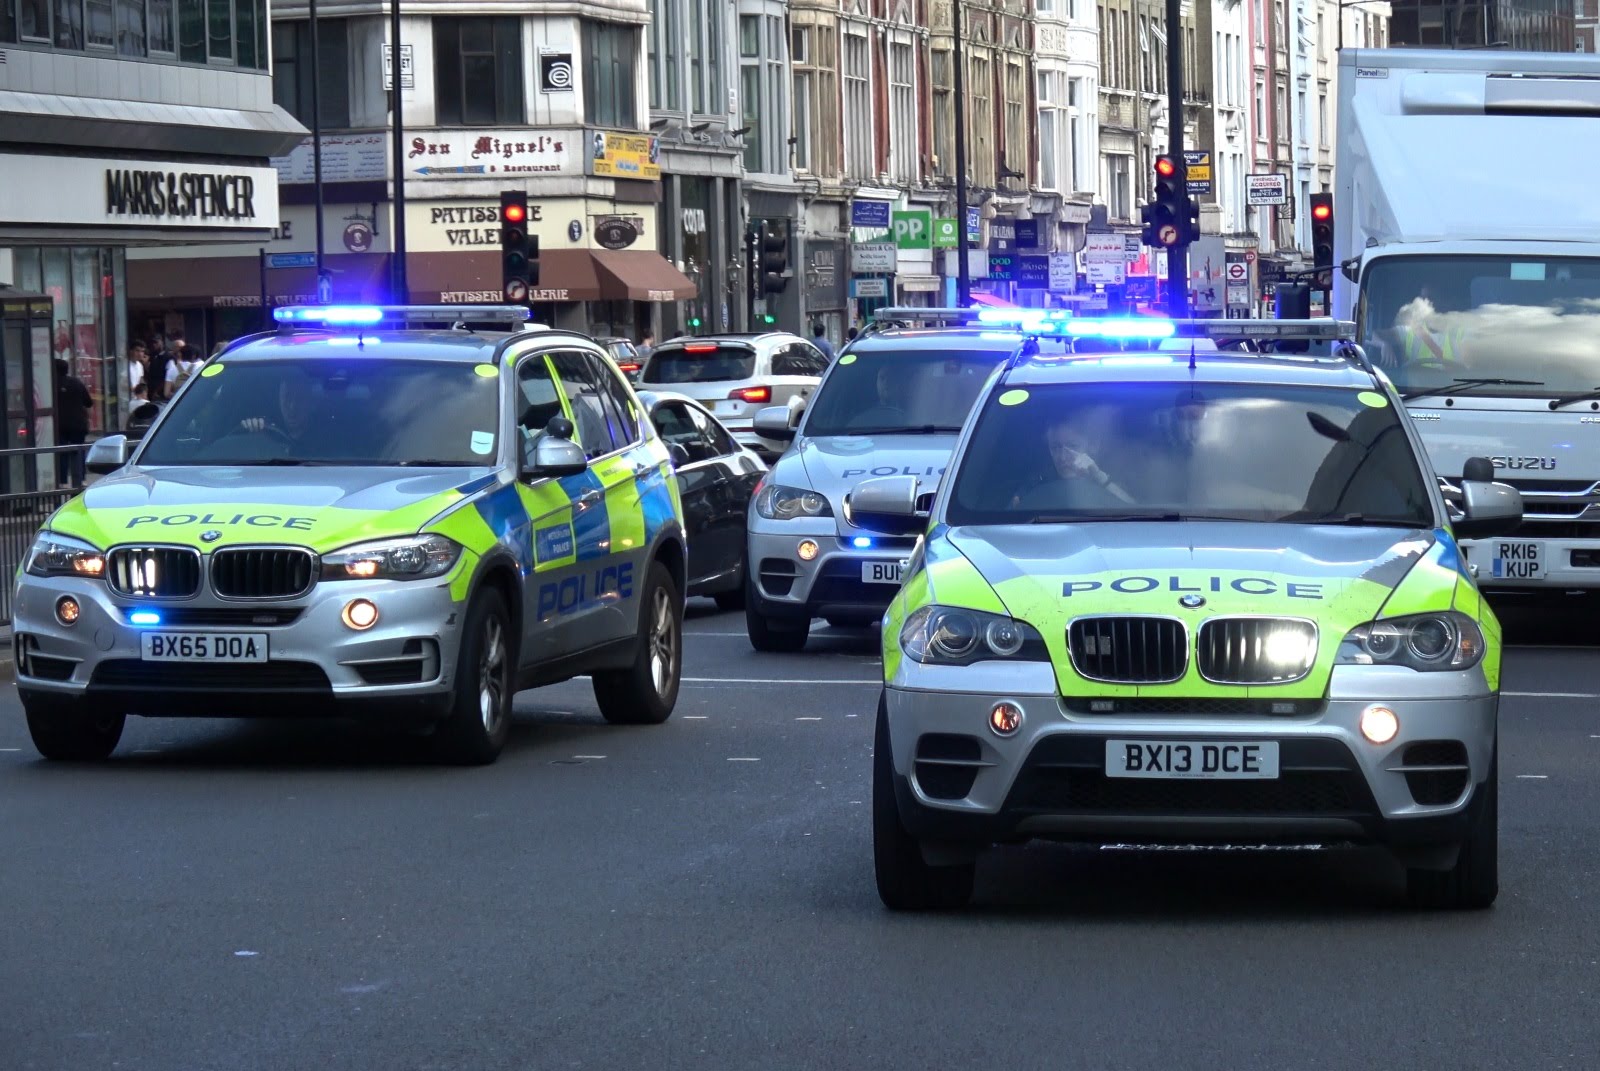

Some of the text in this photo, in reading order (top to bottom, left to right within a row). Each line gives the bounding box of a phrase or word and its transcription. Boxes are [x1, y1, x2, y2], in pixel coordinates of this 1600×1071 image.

[1357, 69, 1387, 77] Panel
[408, 136, 564, 159] San Miguel's
[504, 164, 561, 172] Restaurant
[430, 205, 543, 224] PATISSE
[683, 208, 706, 234] COSTA
[445, 228, 503, 246] VALE
[987, 272, 1012, 280] WINE
[440, 289, 569, 303] PATISSERI LERIE
[1484, 456, 1556, 470] SUZU
[842, 466, 946, 479] POLI
[125, 513, 318, 531] POLICE
[1500, 543, 1538, 560] RK16
[1506, 561, 1539, 578] KUP
[537, 562, 634, 622] POLICE
[1062, 576, 1324, 600] POLICE
[152, 635, 258, 659] BX65 DOA
[1125, 743, 1260, 773] BX13 DCE
